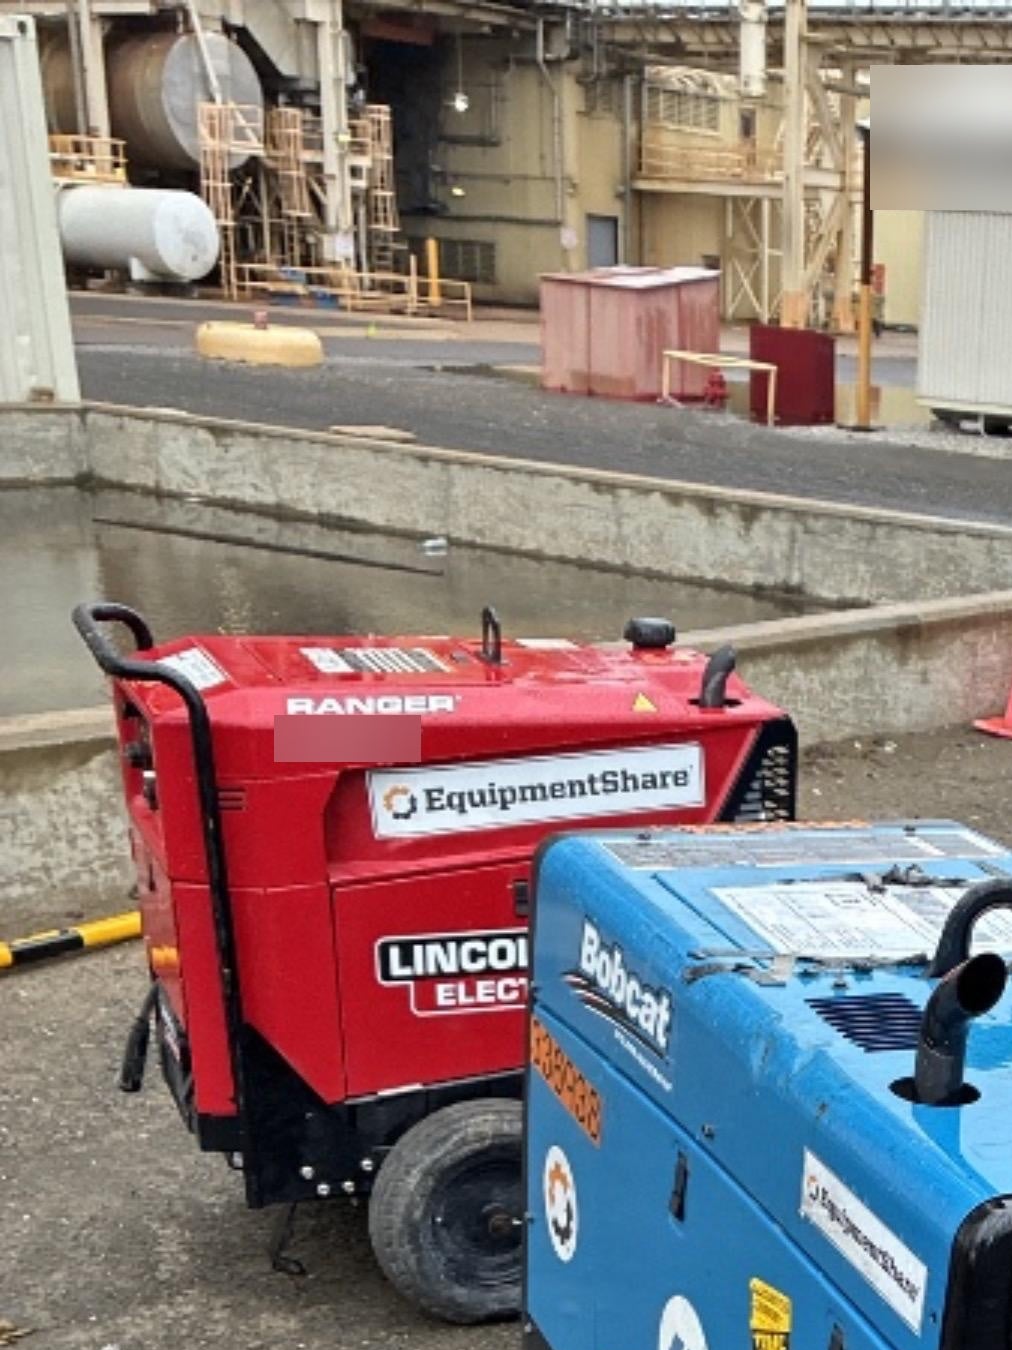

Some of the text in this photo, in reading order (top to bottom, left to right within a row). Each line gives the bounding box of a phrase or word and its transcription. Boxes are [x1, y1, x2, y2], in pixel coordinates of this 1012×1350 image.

[286, 694, 456, 716] RANGER
[423, 766, 691, 815] EquipmentShare
[579, 918, 674, 1049] Bobcat
